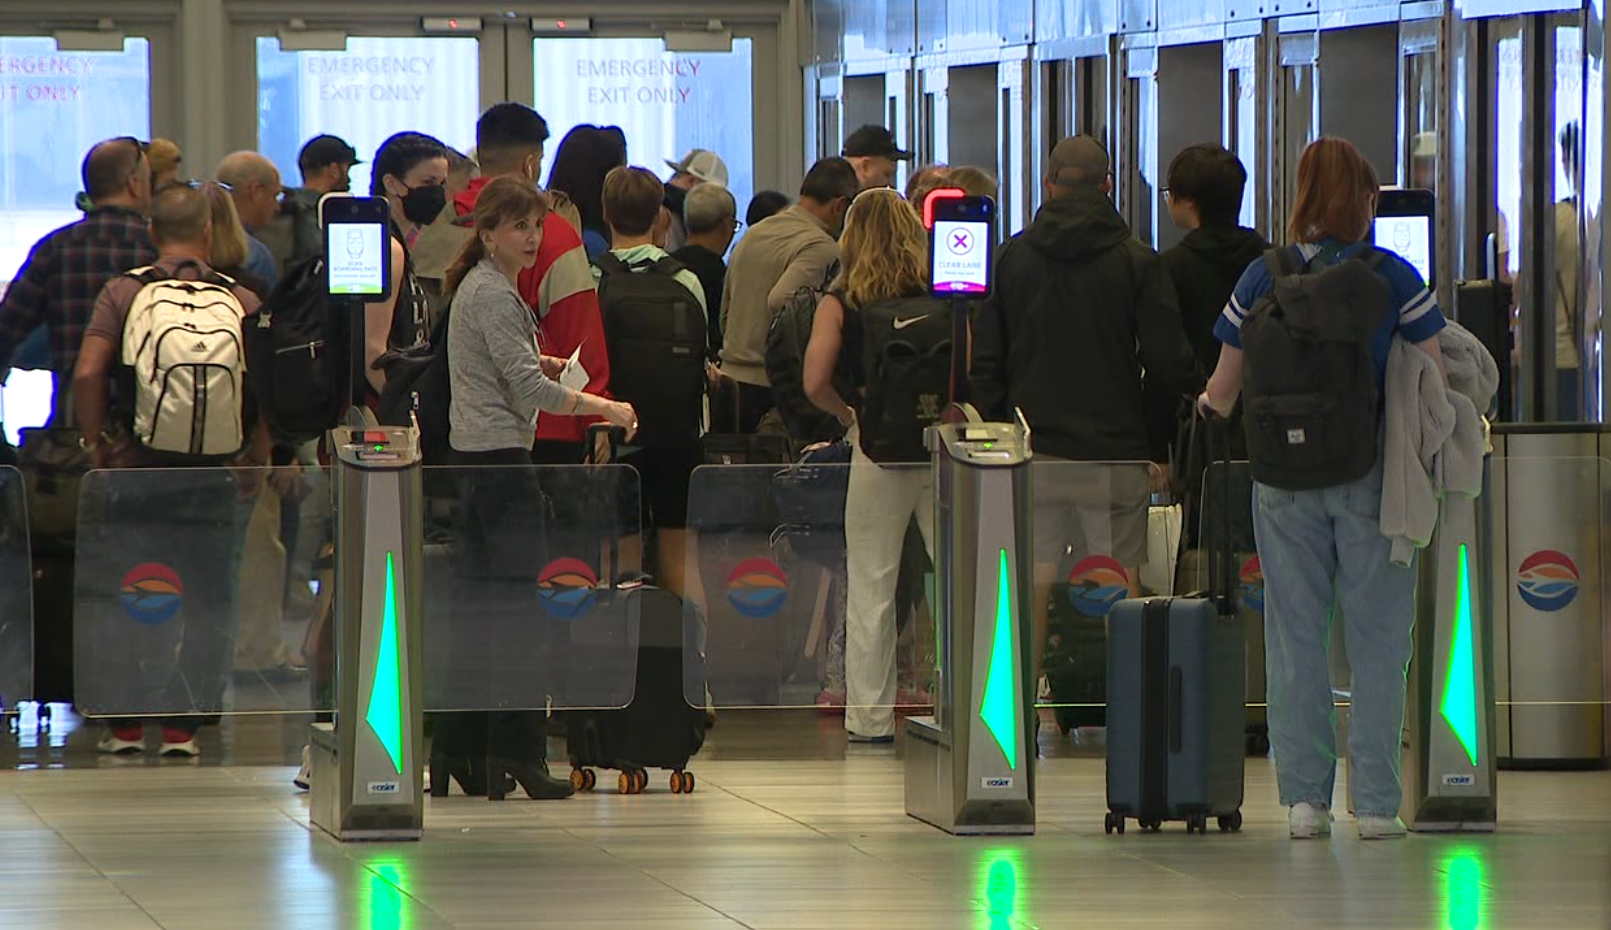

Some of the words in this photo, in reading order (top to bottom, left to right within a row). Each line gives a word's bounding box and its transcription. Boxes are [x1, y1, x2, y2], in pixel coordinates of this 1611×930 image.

[307, 56, 436, 75] EMERGENCY
[576, 58, 701, 78] EMERGENCY
[25, 83, 81, 102] ONLY
[320, 84, 363, 102] EXIT
[369, 83, 425, 102] ONLY
[588, 86, 631, 104] EXIT
[636, 86, 692, 105] ONLY
[938, 261, 961, 269] CLEAR
[962, 261, 982, 269] LANE
